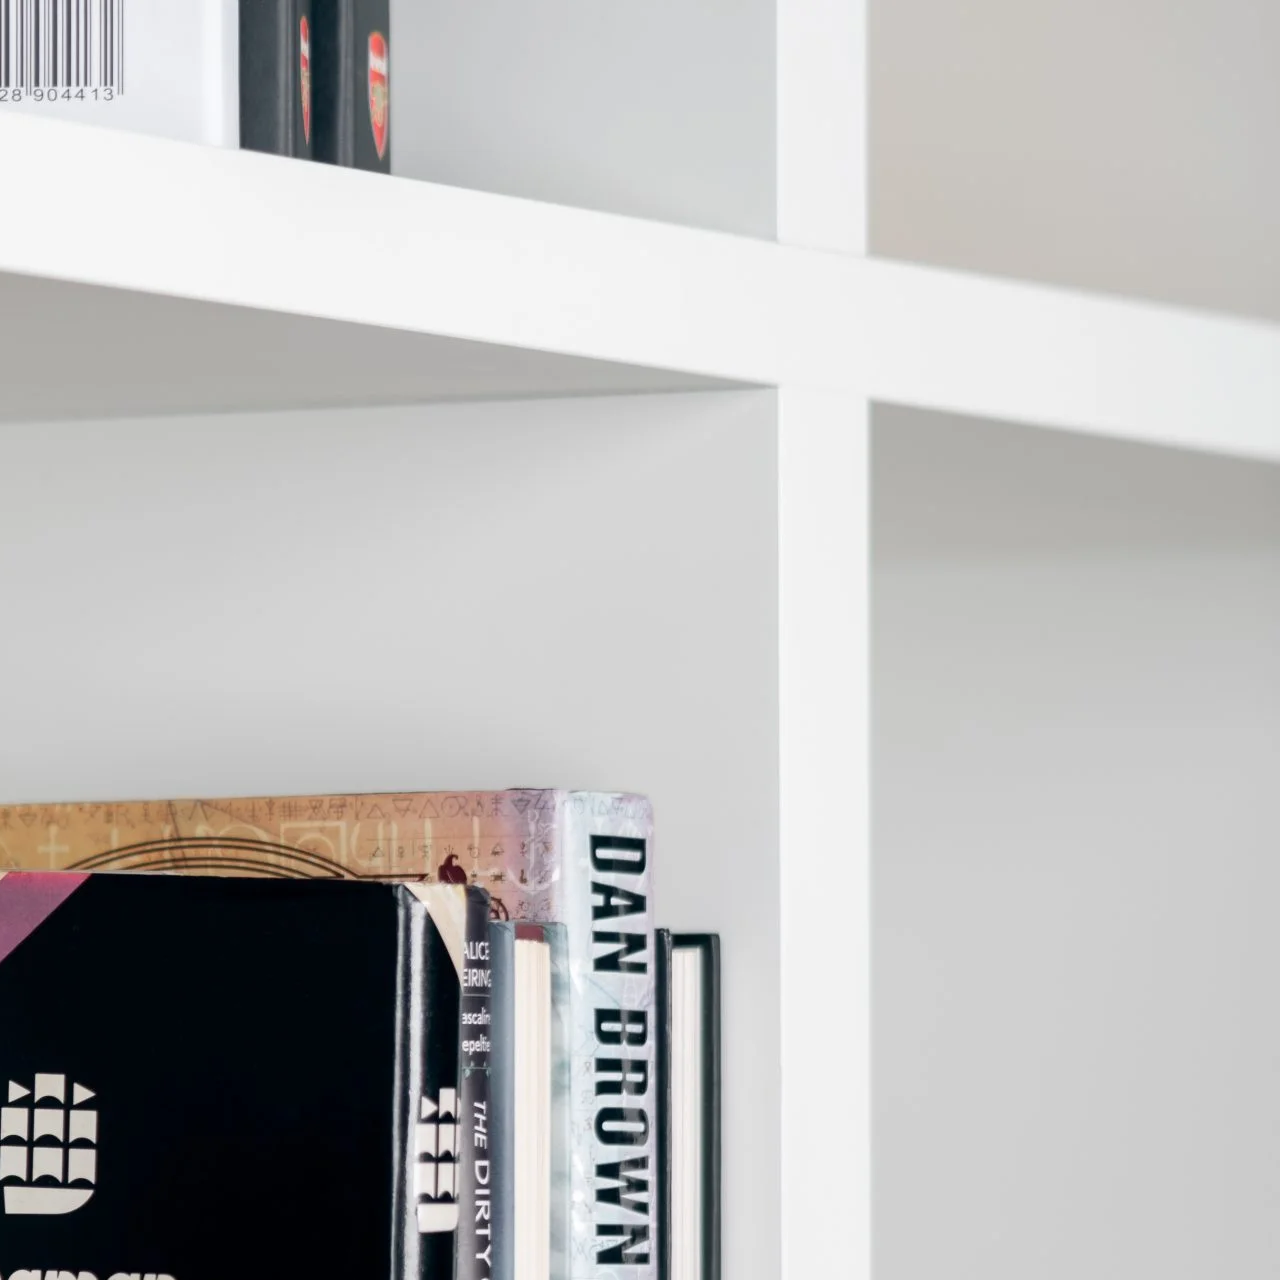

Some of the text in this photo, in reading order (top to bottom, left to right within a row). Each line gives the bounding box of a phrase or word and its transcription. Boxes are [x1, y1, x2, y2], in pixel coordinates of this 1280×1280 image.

[463, 968, 492, 988] EIRING
[461, 1006, 491, 1025] ascalin
[461, 1033, 491, 1056] epeltie
[589, 834, 650, 1265] DAN BROWN
[473, 1101, 488, 1150] THE
[474, 1160, 492, 1268] DIRTY
